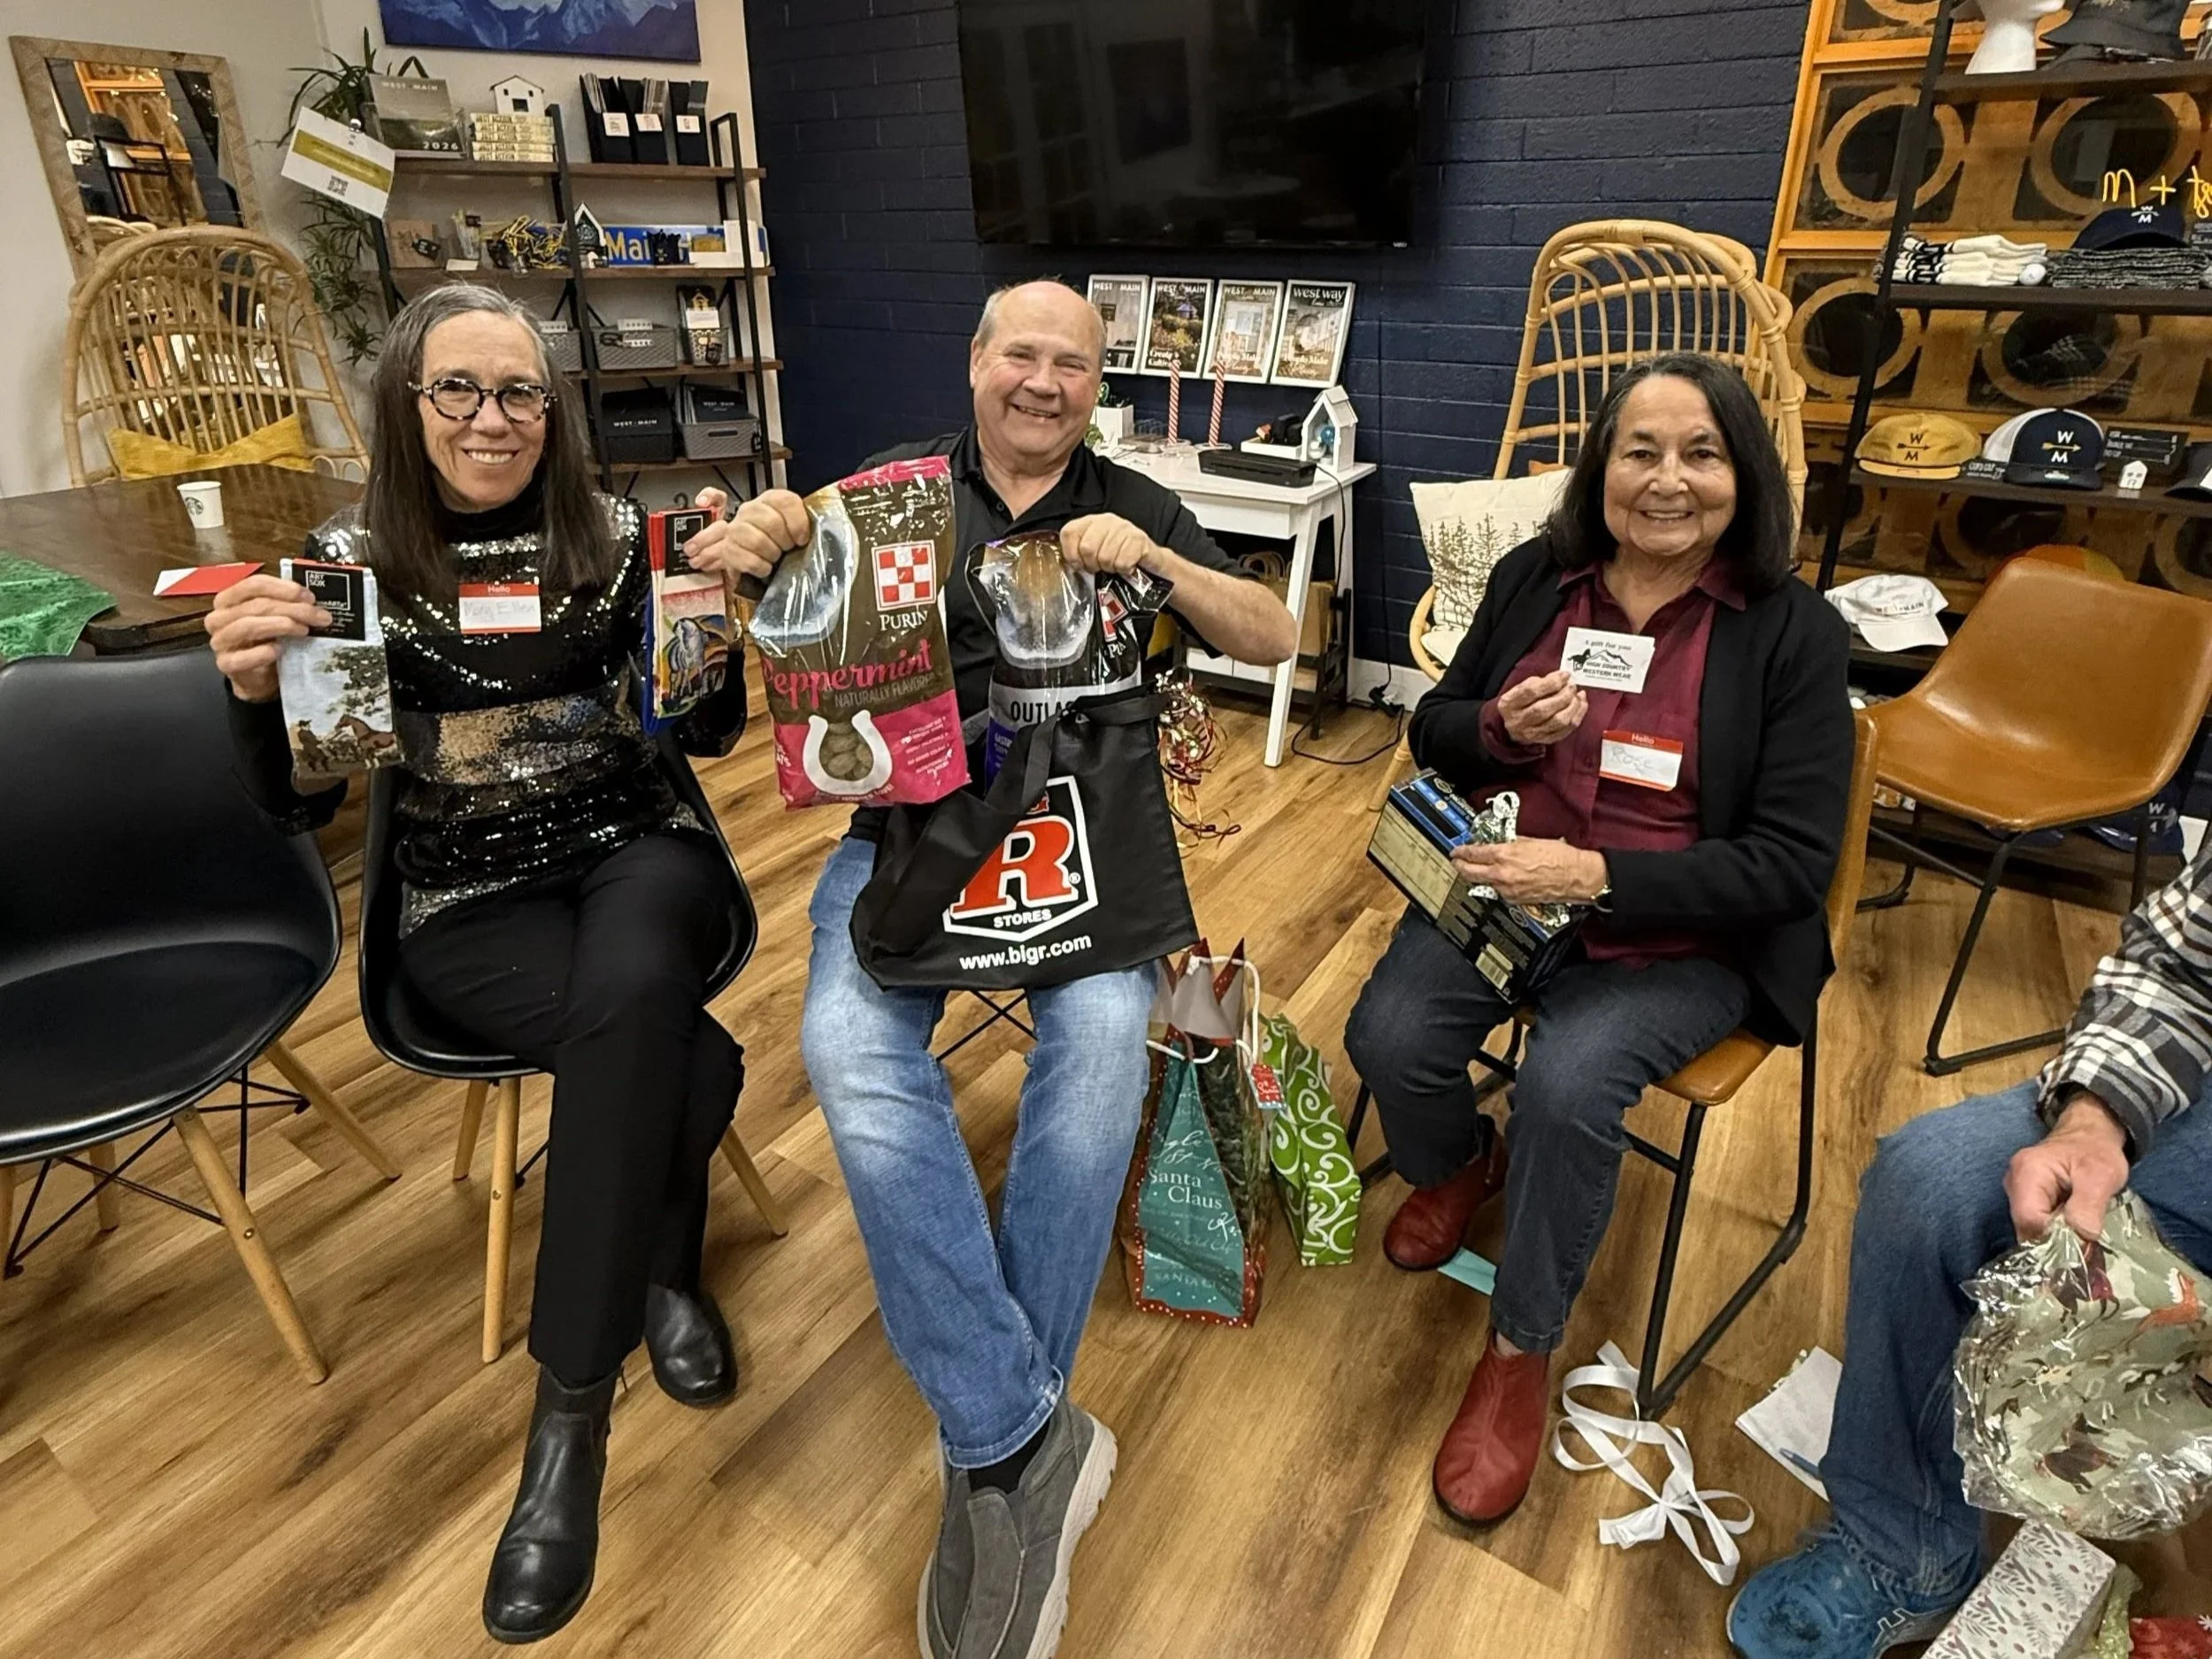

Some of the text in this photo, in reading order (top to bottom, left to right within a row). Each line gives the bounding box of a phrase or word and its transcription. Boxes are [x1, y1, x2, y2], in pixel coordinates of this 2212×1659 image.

[422, 142, 458, 150] 2026
[2138, 213, 2152, 224] M
[1094, 282, 1141, 292] WEST MAIN
[1156, 284, 1206, 294] WEST MAIN
[1224, 286, 1245, 295] WEST
[1293, 288, 1321, 299] west
[1321, 289, 1345, 303] way
[1909, 433, 1924, 444] W
[2057, 430, 2075, 443] W
[1904, 450, 1919, 461] M
[2051, 450, 2069, 464] M
[487, 584, 511, 594] Hello
[495, 600, 535, 615] Ellen
[1582, 667, 1612, 677] WESTERN
[1601, 663, 1632, 672] COUNTRY
[833, 685, 891, 708] NATURALLY
[1631, 733, 1655, 745] Hello
[2148, 802, 2165, 815] W
[994, 908, 1052, 928] STORES
[958, 934, 1093, 971] www.bigr.com
[1148, 1166, 1202, 1188] Santa
[1167, 1185, 1223, 1210] Claus
